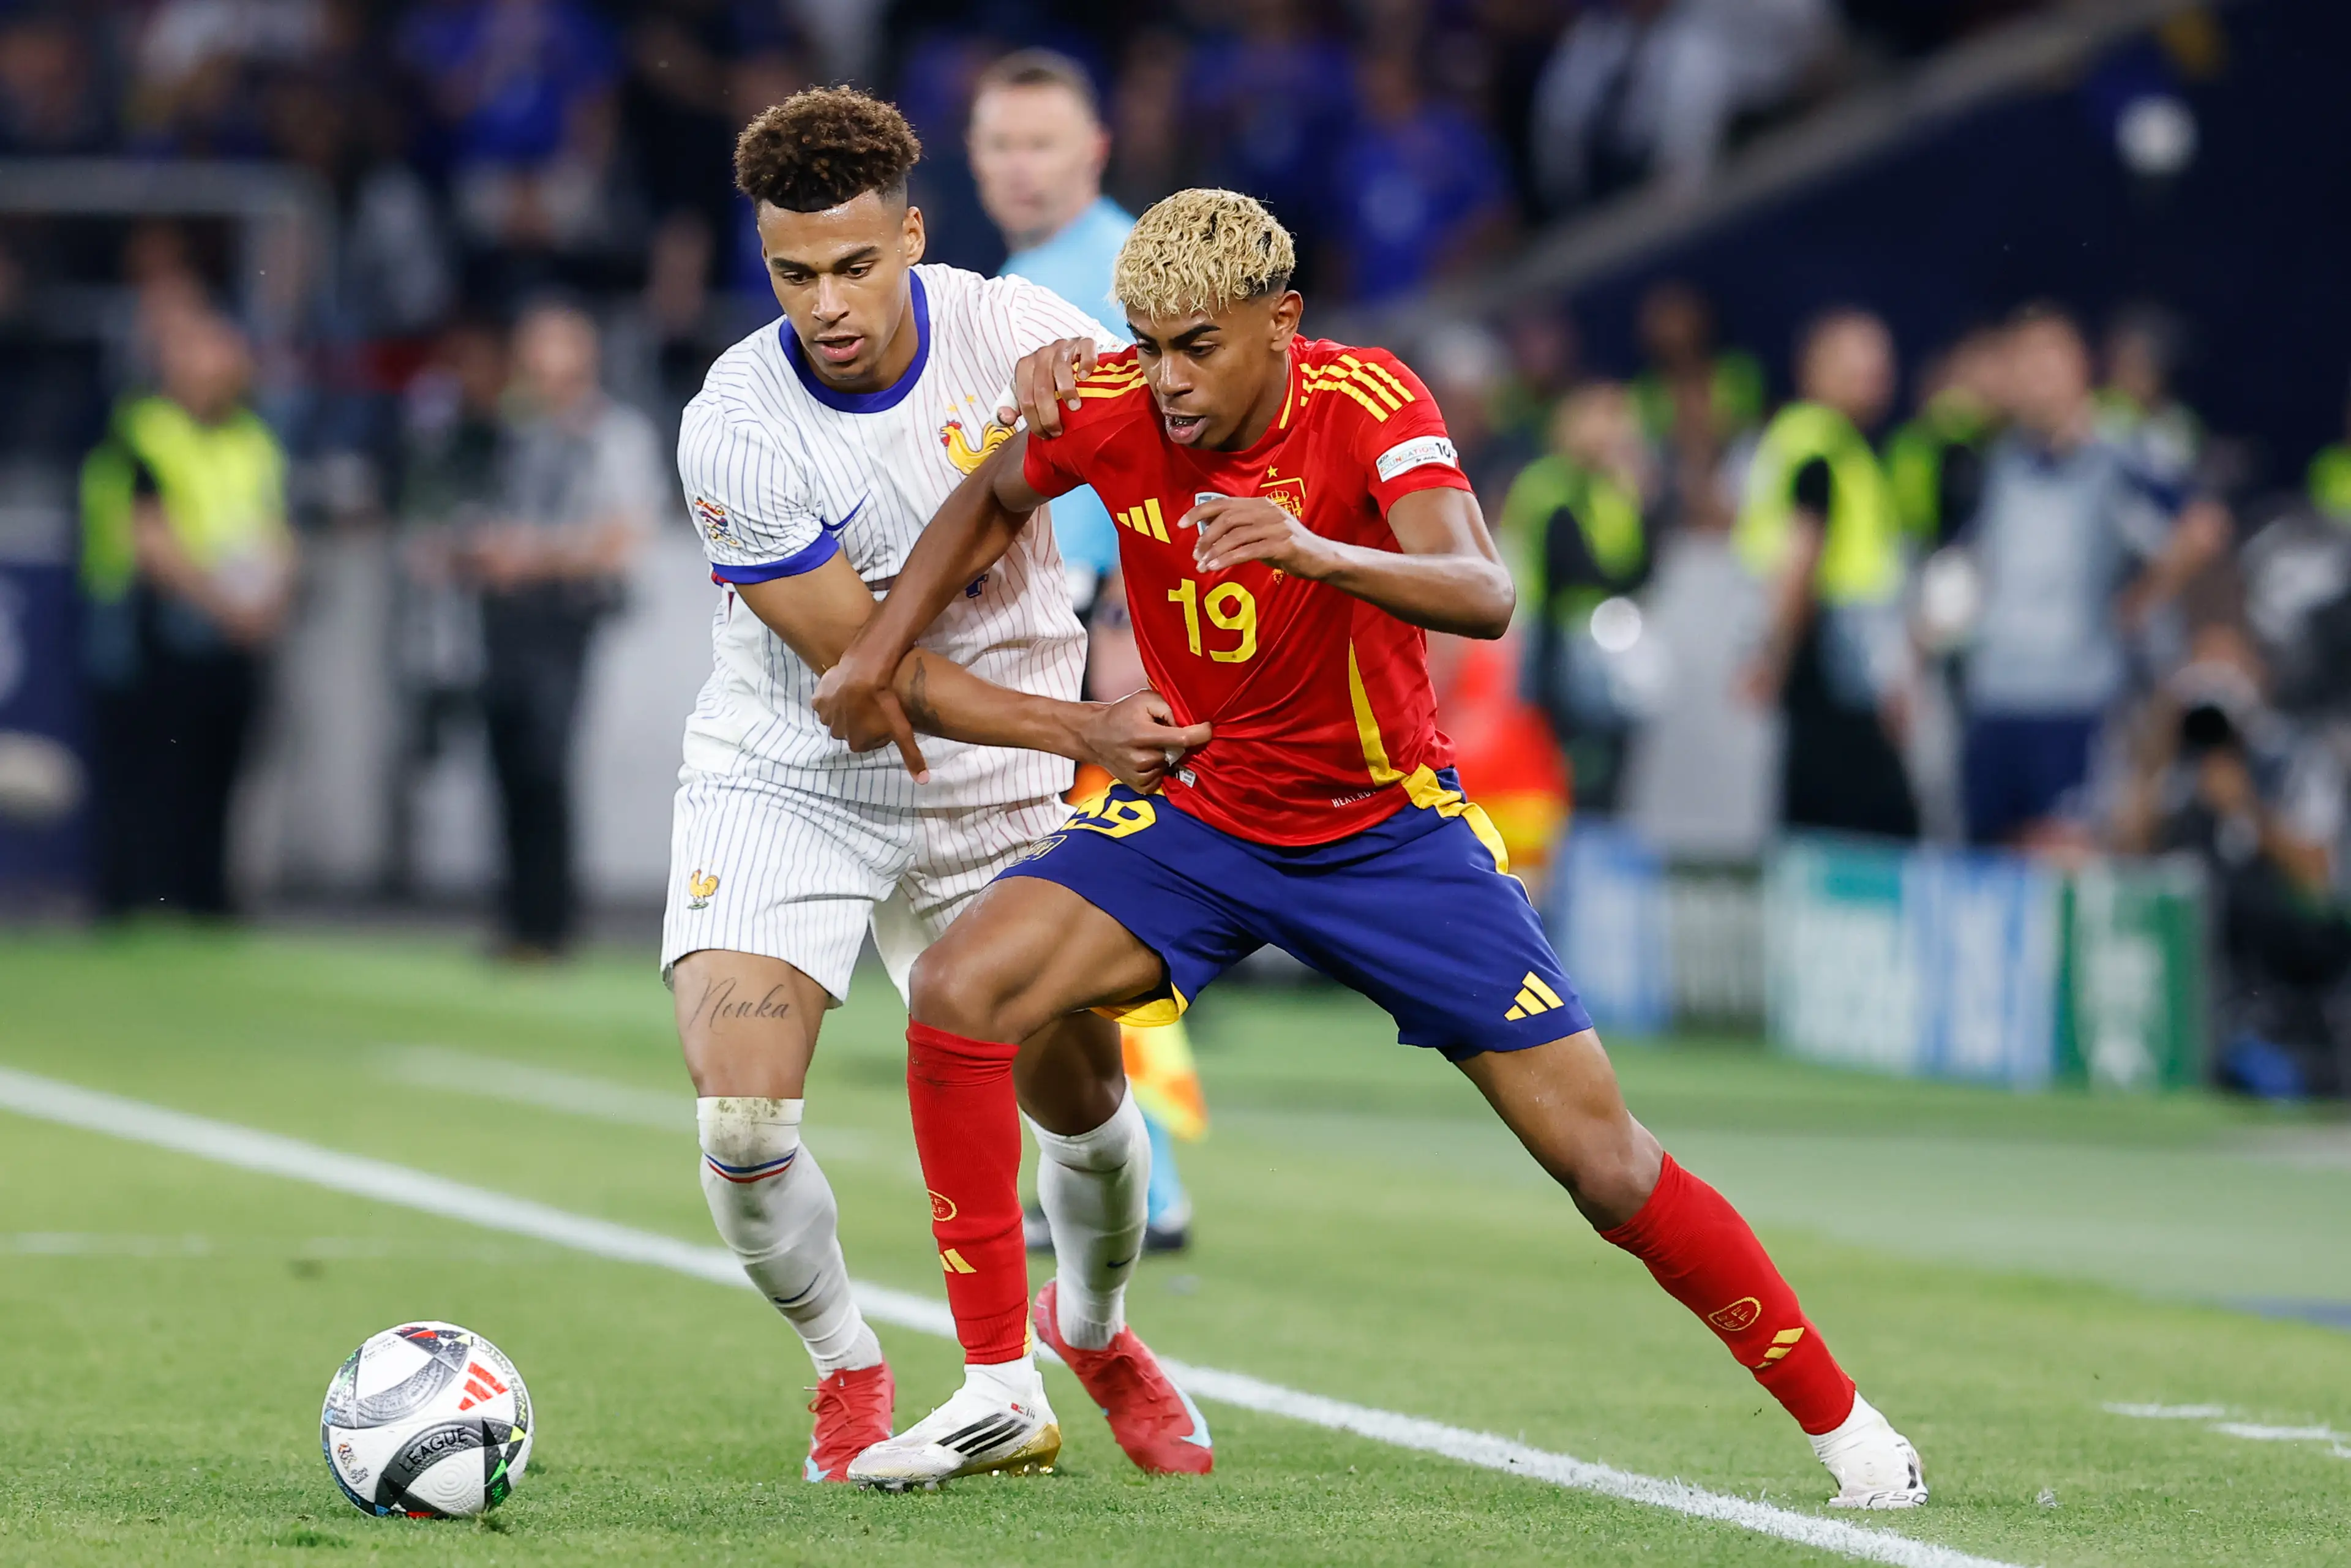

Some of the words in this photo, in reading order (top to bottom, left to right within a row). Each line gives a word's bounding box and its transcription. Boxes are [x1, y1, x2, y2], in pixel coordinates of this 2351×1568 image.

[1380, 446, 1436, 473] FOUNDATION
[1168, 578, 1257, 663] 19
[1331, 790, 1376, 808] HEAT.RD
[399, 1427, 468, 1473] LEAGUE
